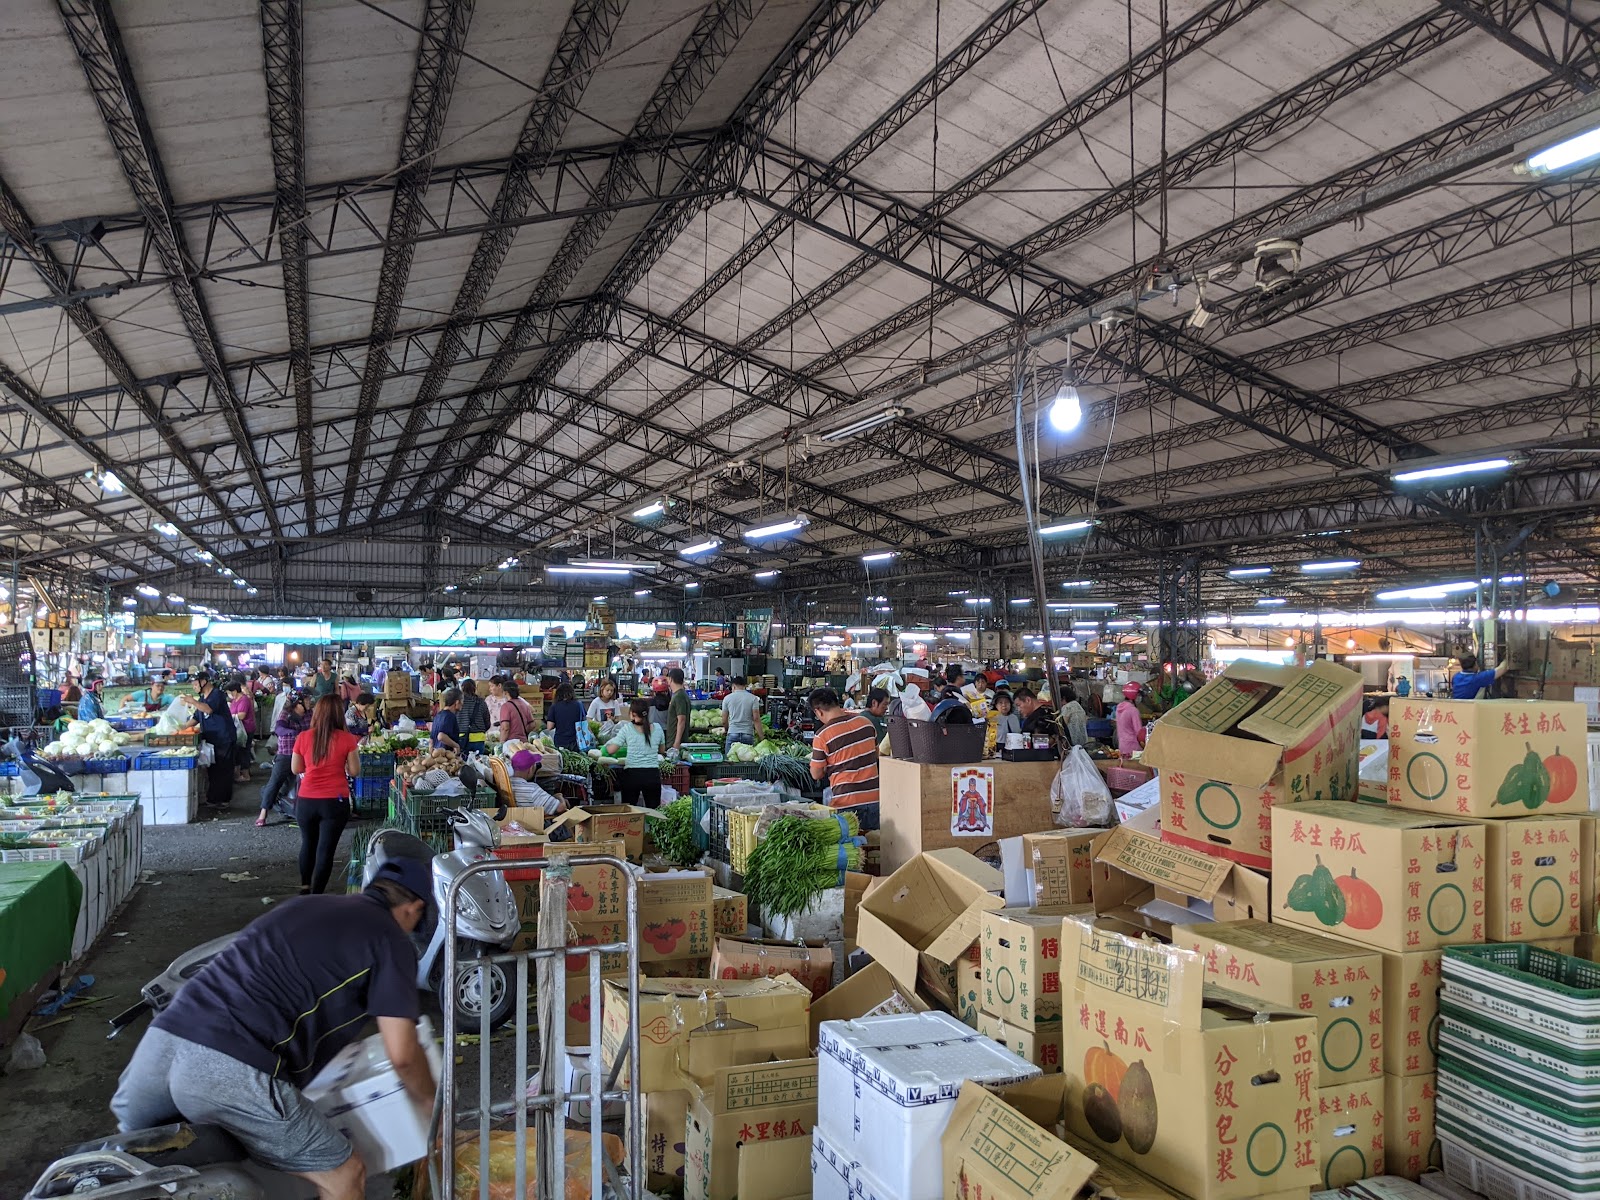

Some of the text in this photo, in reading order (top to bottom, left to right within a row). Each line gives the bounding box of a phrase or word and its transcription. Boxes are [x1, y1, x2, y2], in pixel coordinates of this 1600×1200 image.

[1402, 705, 1458, 725] 養生南瓜
[1501, 712, 1567, 735] 養生南瓜
[1389, 724, 1402, 802] 品質保証
[1290, 820, 1366, 854] 養生南瓜
[1420, 833, 1474, 852] 養生南瓜
[1522, 829, 1570, 845] 養生南瓜
[610, 868, 619, 914] 夏季高山
[1407, 858, 1421, 946] 品質保証
[1472, 853, 1485, 939] 分級包裝
[1510, 851, 1523, 936] 品質保証
[699, 909, 709, 953] 夏季高山
[1019, 936, 1029, 1020] 品質保證
[1041, 937, 1060, 994] 特選
[1313, 965, 1370, 987] 養生南瓜
[1080, 1004, 1152, 1053] 特選南瓜
[1368, 985, 1382, 1074] 分級包裝
[1406, 983, 1421, 1070] 品質保証
[1041, 1044, 1059, 1066] 特
[731, 1075, 750, 1084] 品名
[1292, 1035, 1316, 1168] 品質保証
[1214, 1044, 1239, 1183] 分級包裝
[1318, 1092, 1372, 1115] 養生南瓜
[738, 1119, 806, 1142] 水里絲瓜
[1407, 1107, 1421, 1171] 品質保
[651, 1132, 667, 1176] 特選
